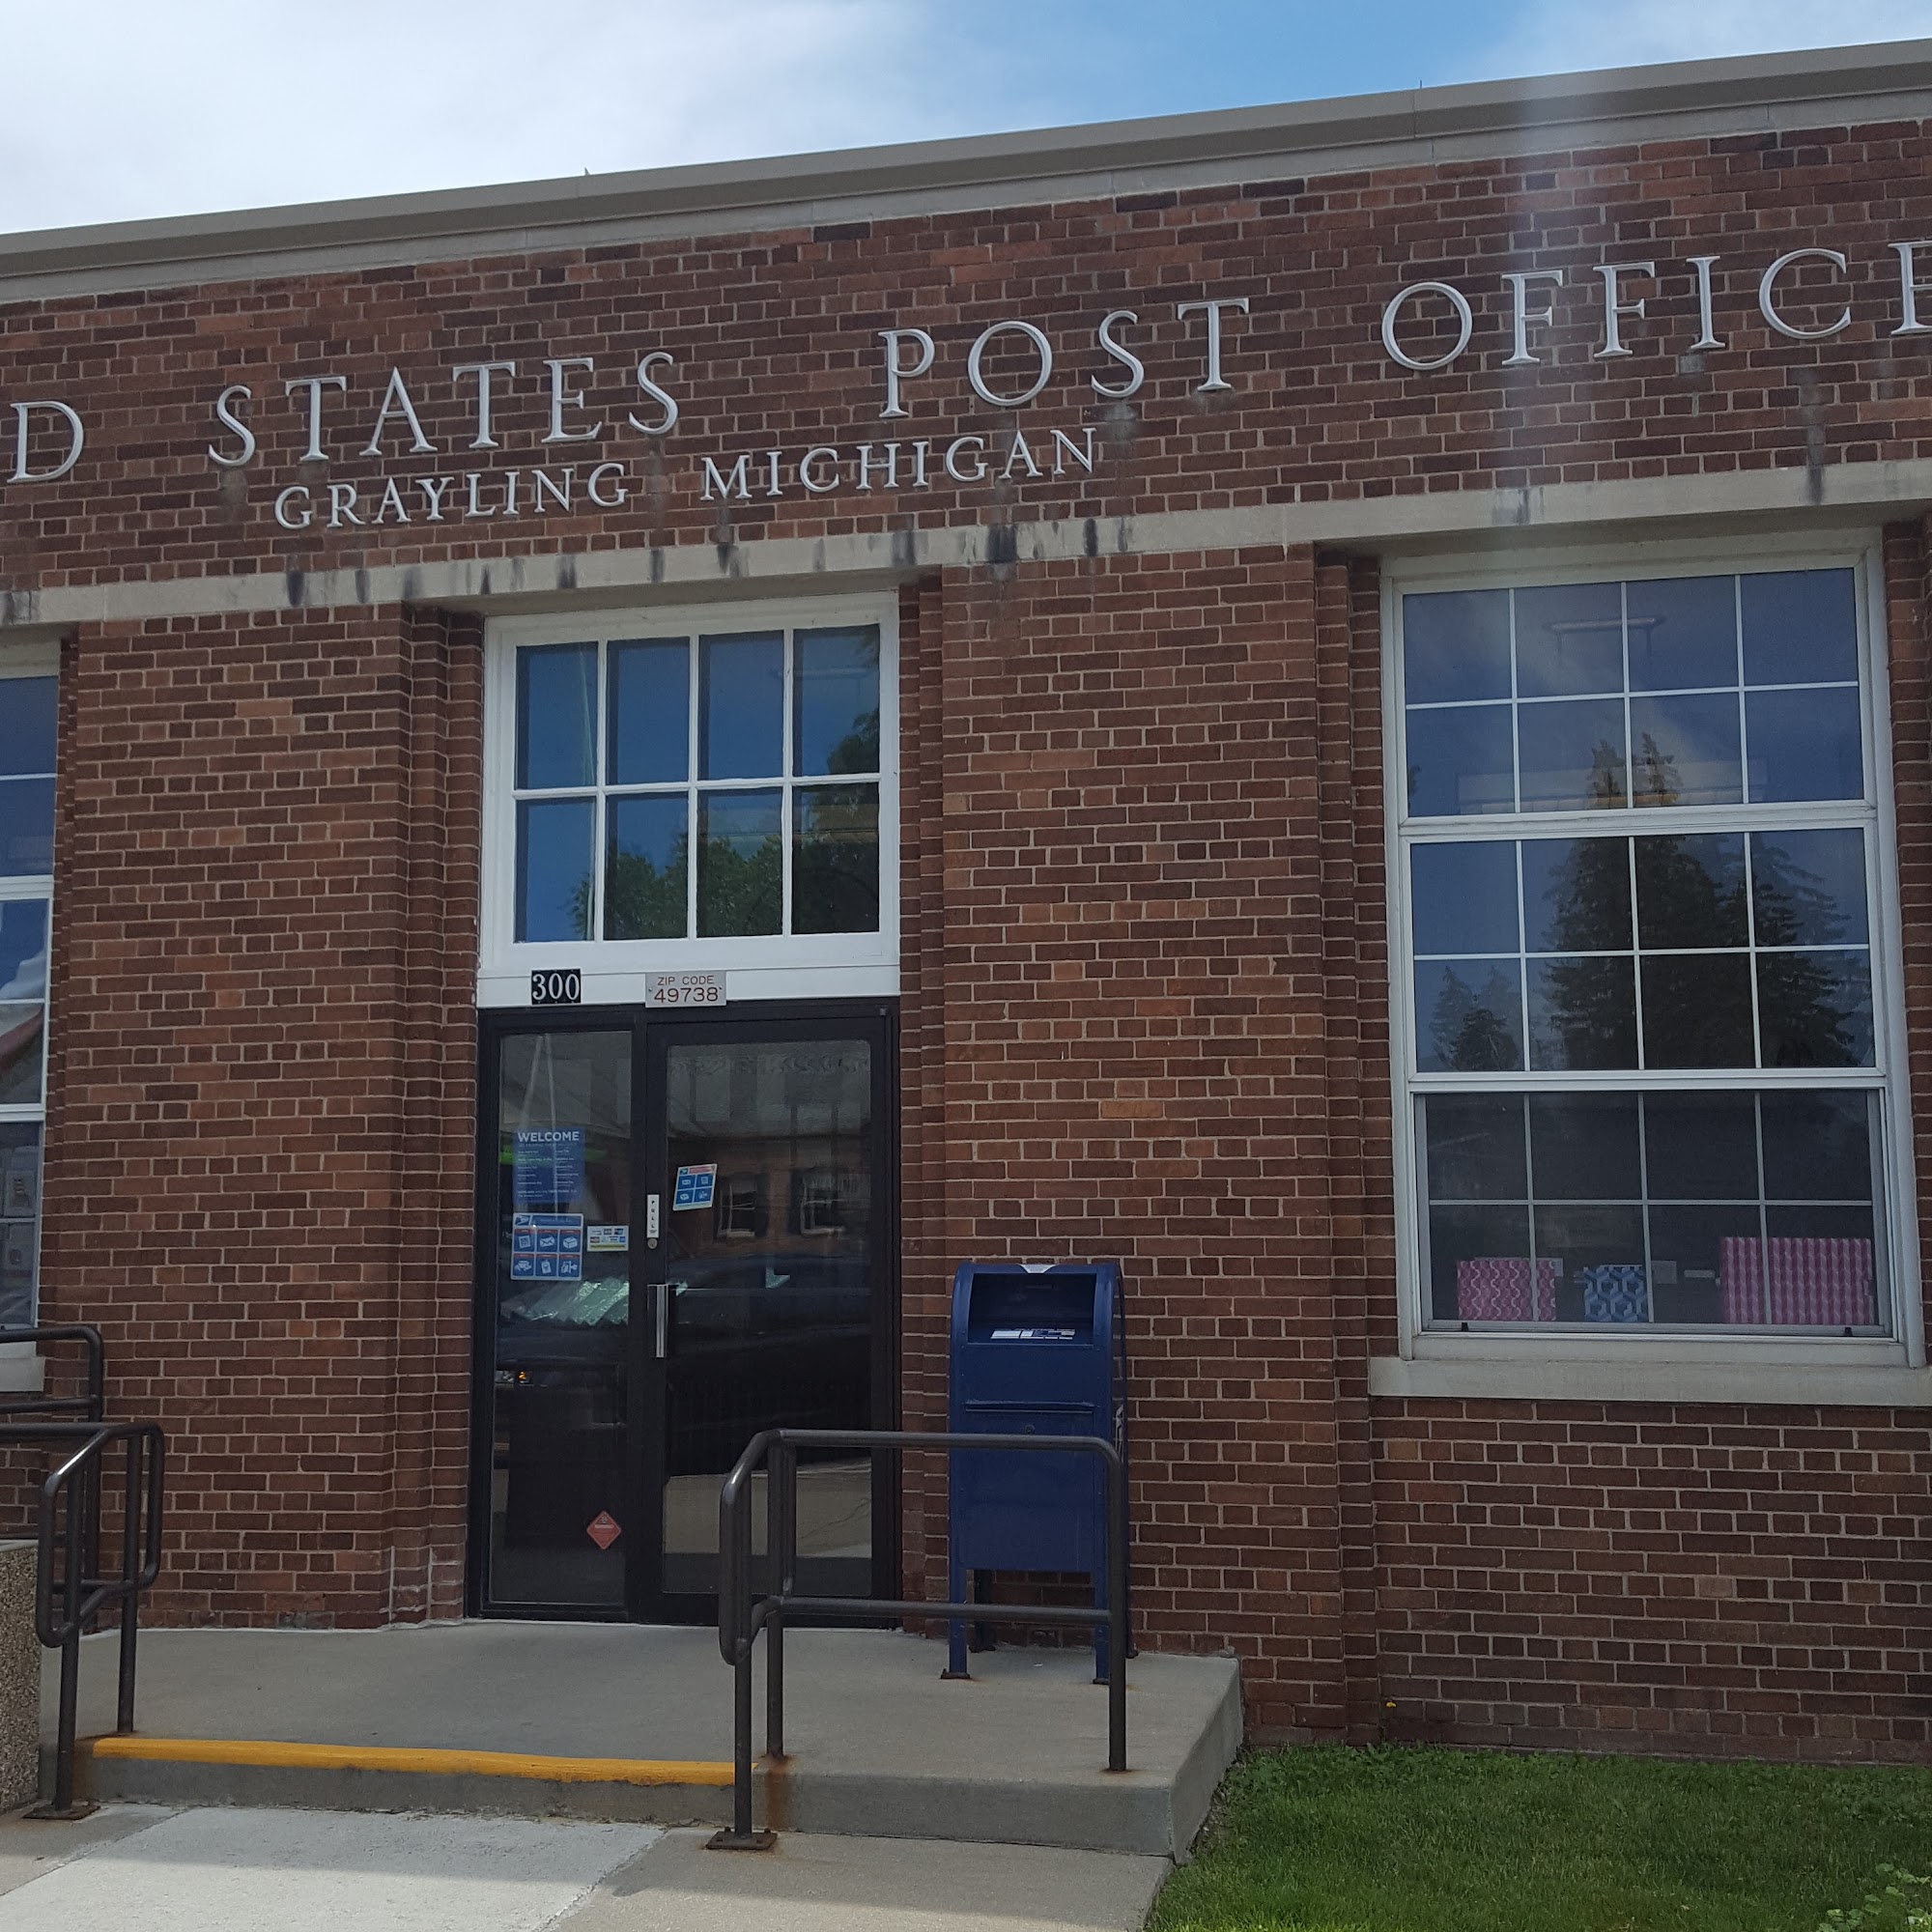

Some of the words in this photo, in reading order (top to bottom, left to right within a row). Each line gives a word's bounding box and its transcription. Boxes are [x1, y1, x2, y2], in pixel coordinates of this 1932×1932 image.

[208, 352, 679, 468] STATES
[878, 298, 1250, 418] POST
[1381, 241, 1932, 371] OFFICE
[274, 463, 629, 530] GRAYLING
[699, 427, 1097, 501] MICHIGAN
[532, 972, 581, 1001] 300
[657, 976, 676, 986] ZIP
[682, 975, 715, 985] CODE
[653, 986, 720, 1004] 49738
[517, 1131, 580, 1143] WELCOME
